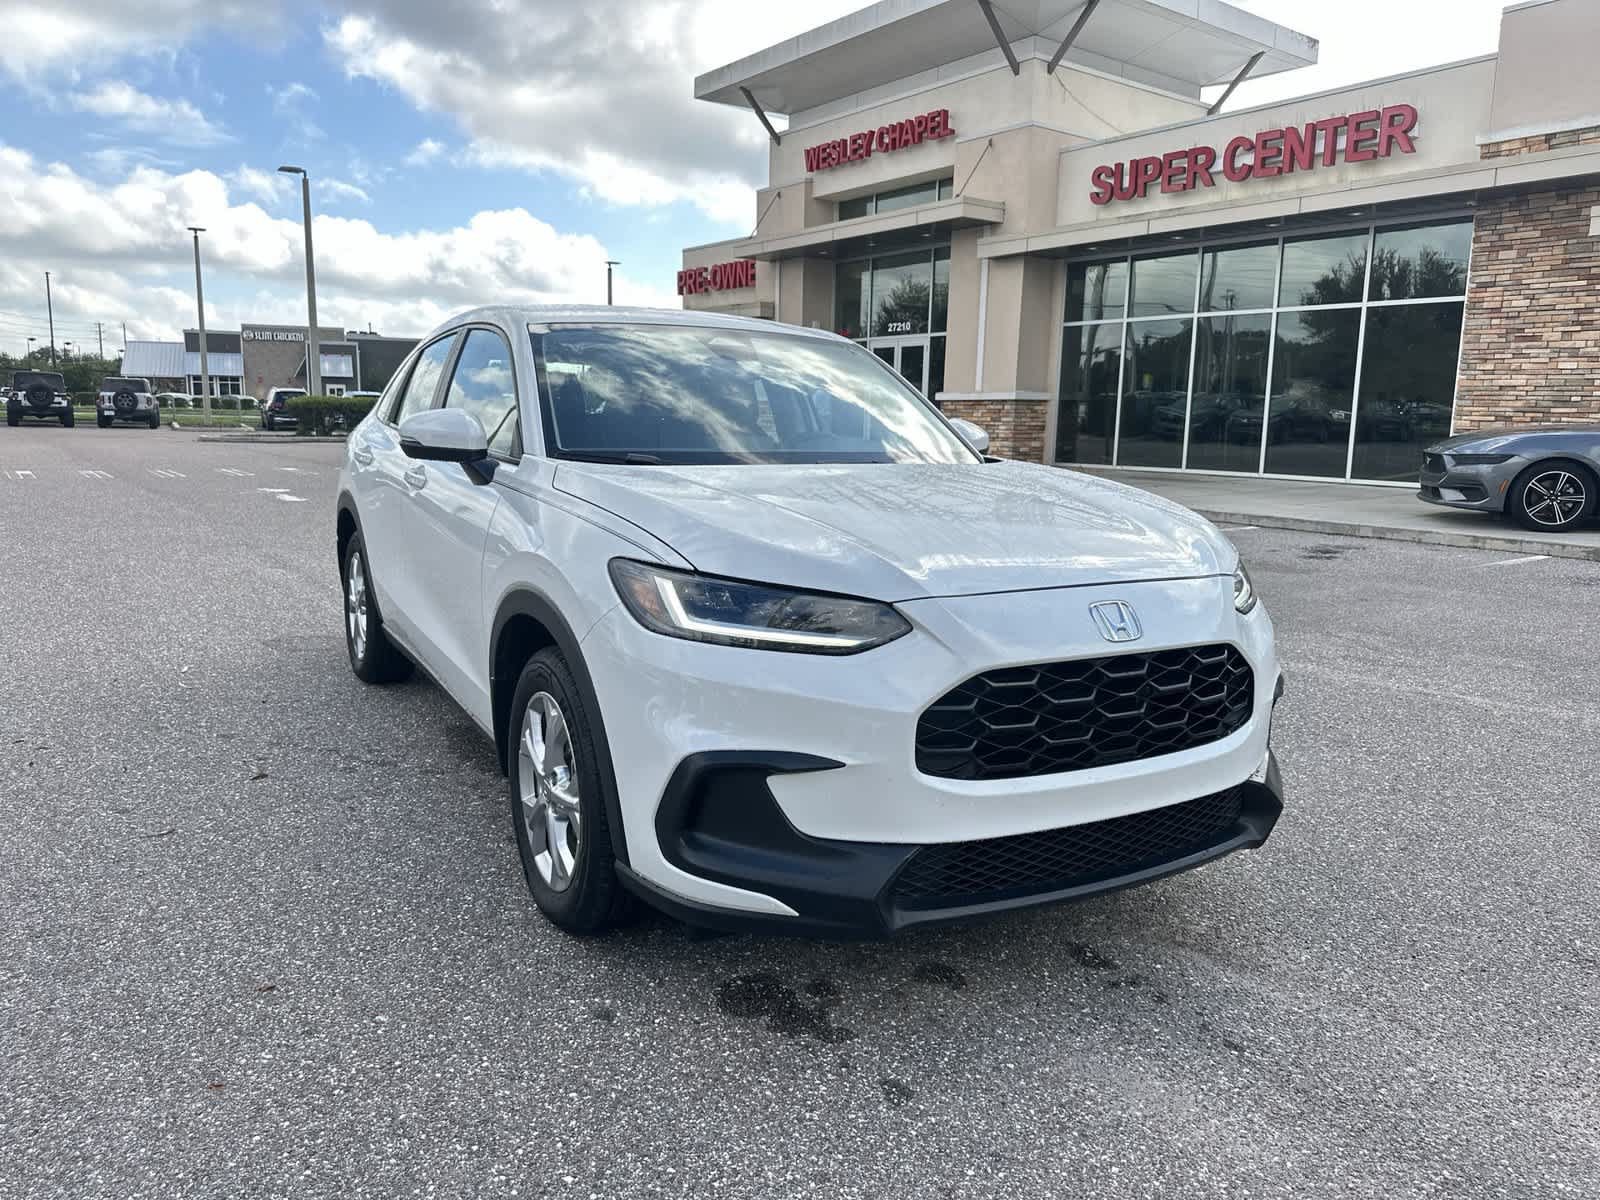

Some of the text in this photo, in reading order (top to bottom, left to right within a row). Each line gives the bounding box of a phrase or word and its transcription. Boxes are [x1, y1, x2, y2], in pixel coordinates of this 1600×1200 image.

[804, 108, 954, 172] WESLEY CHAPEL
[1090, 104, 1418, 206] SUPER CENTER
[254, 331, 304, 342] SLIM CHICKENS
[888, 321, 911, 332] 27210
